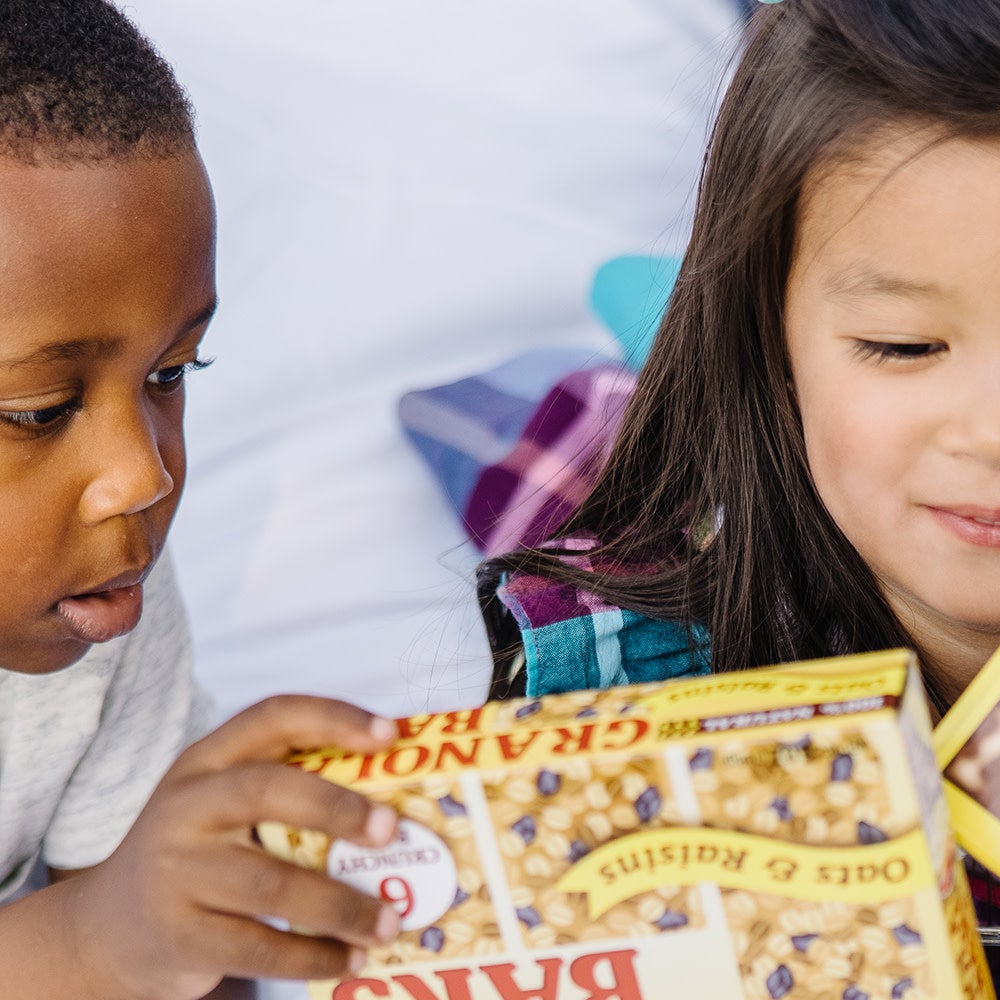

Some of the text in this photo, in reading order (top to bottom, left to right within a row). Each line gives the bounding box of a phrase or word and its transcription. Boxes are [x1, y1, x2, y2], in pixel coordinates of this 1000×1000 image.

[336, 848, 442, 875] CRUNCHY
[598, 841, 911, 885] Oats & Raisins
[379, 876, 415, 919] 6
